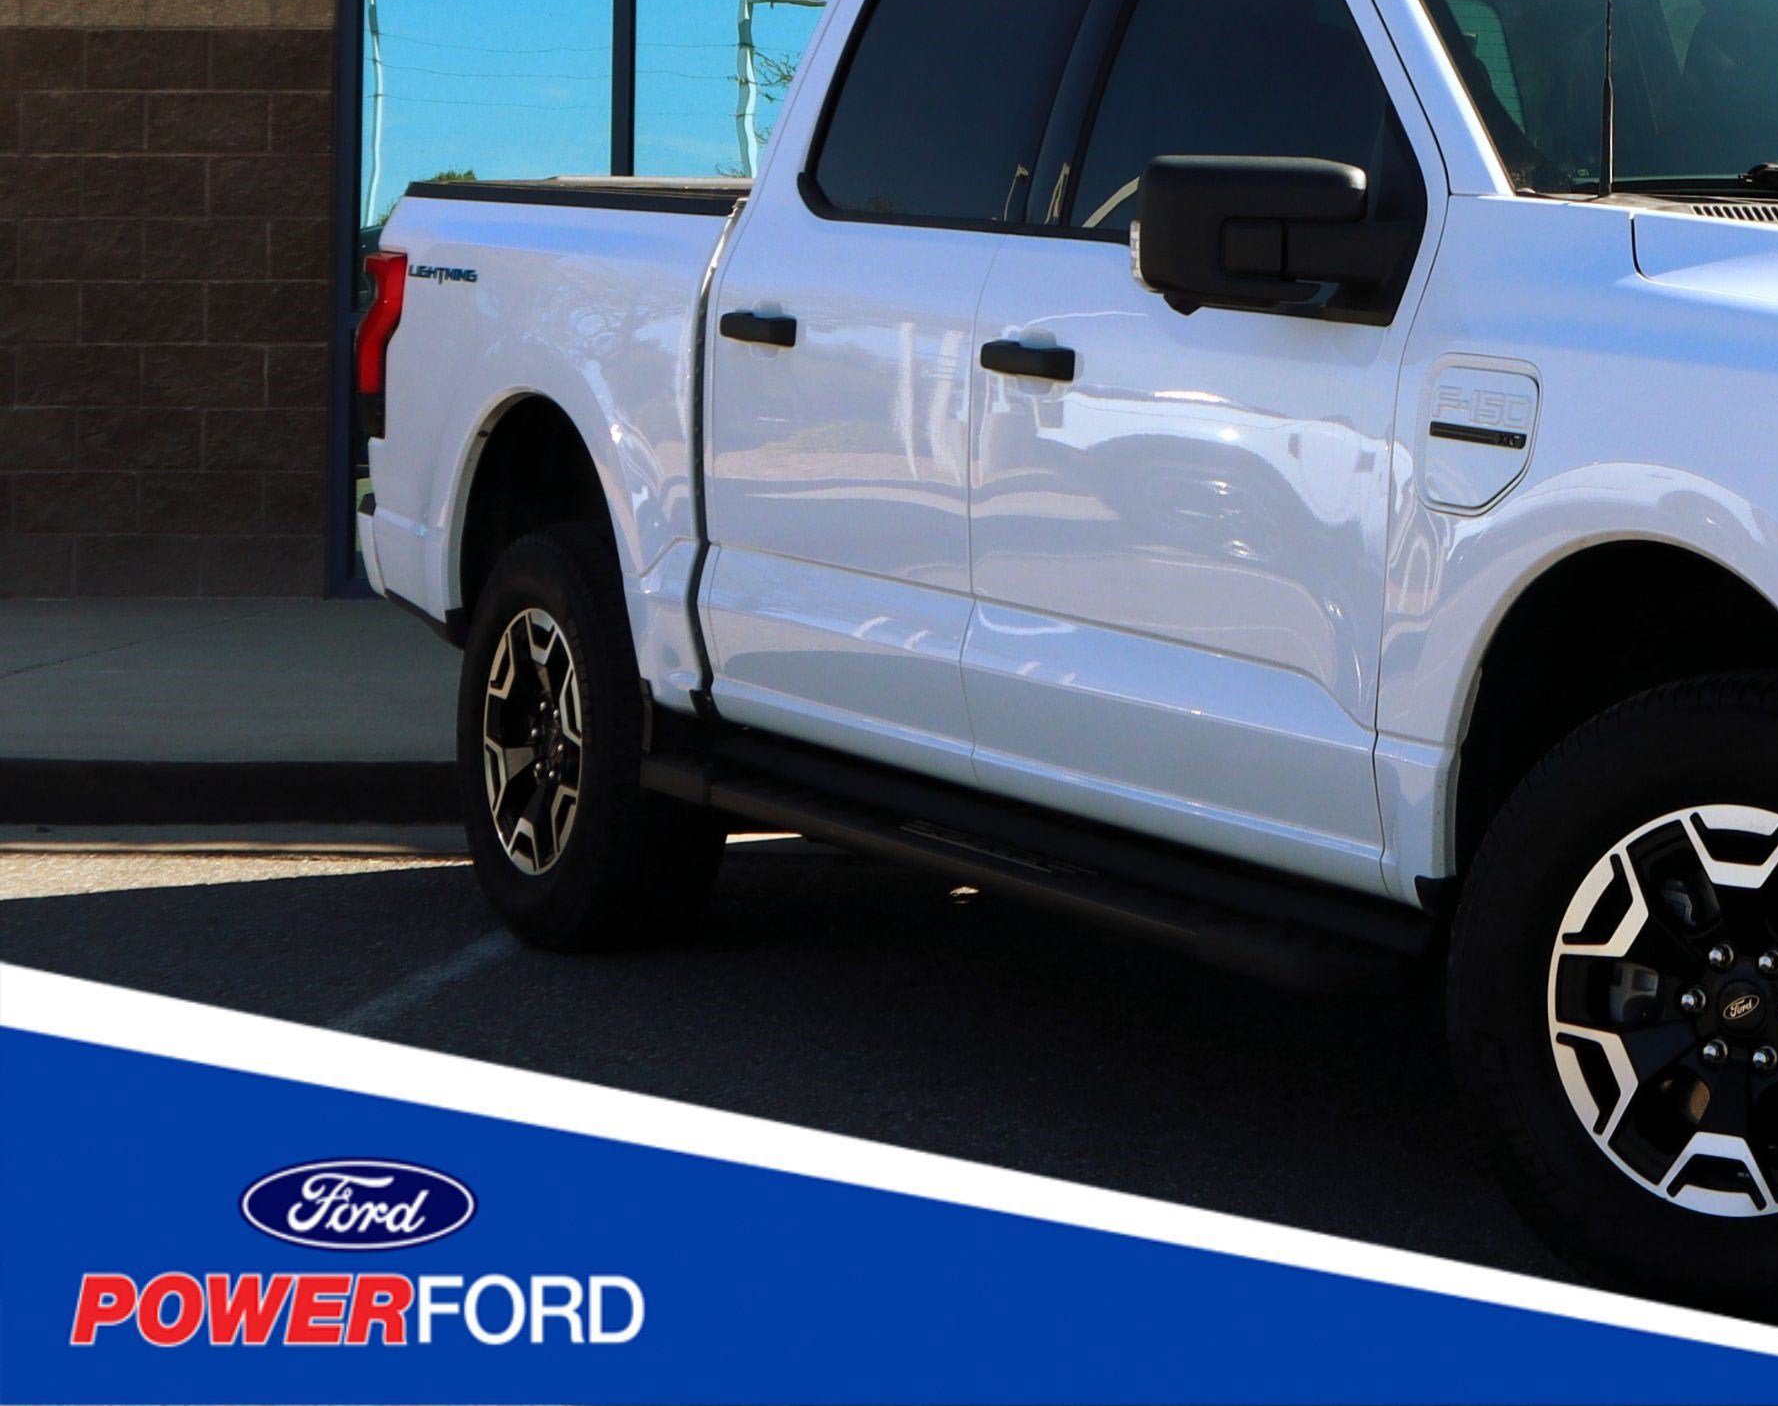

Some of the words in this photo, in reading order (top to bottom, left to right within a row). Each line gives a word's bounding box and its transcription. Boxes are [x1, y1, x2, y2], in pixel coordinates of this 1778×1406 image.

[408, 265, 478, 285] LIGHTNING
[1432, 385, 1532, 429] F-150
[1729, 999, 1752, 1017] Ford
